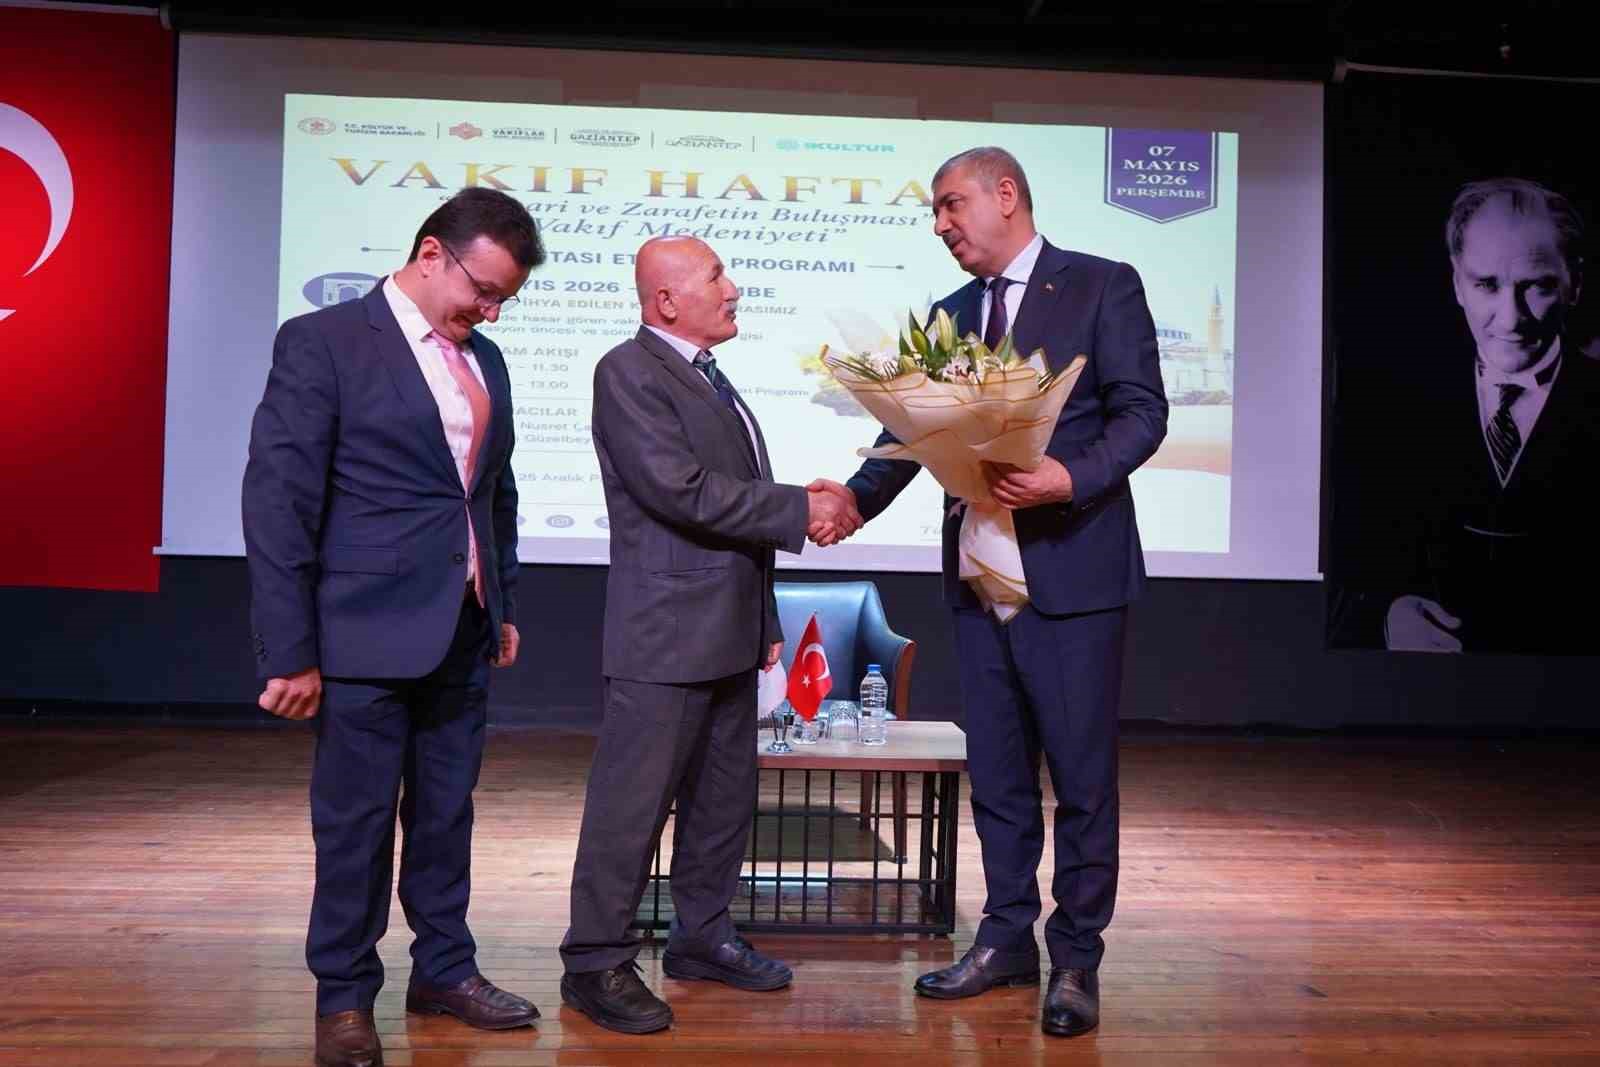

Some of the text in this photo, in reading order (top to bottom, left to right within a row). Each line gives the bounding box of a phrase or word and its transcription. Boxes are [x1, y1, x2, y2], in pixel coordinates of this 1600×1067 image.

[1149, 146, 1176, 156] 07
[1124, 159, 1200, 171] MAYIS
[330, 157, 932, 208] VAKIF HAFTA
[1136, 174, 1187, 185] 2026
[527, 201, 568, 213] ari
[580, 204, 610, 215] ve
[621, 201, 758, 222] Zarafetin
[731, 258, 855, 273] PROGRAMI
[565, 281, 620, 293] 2026
